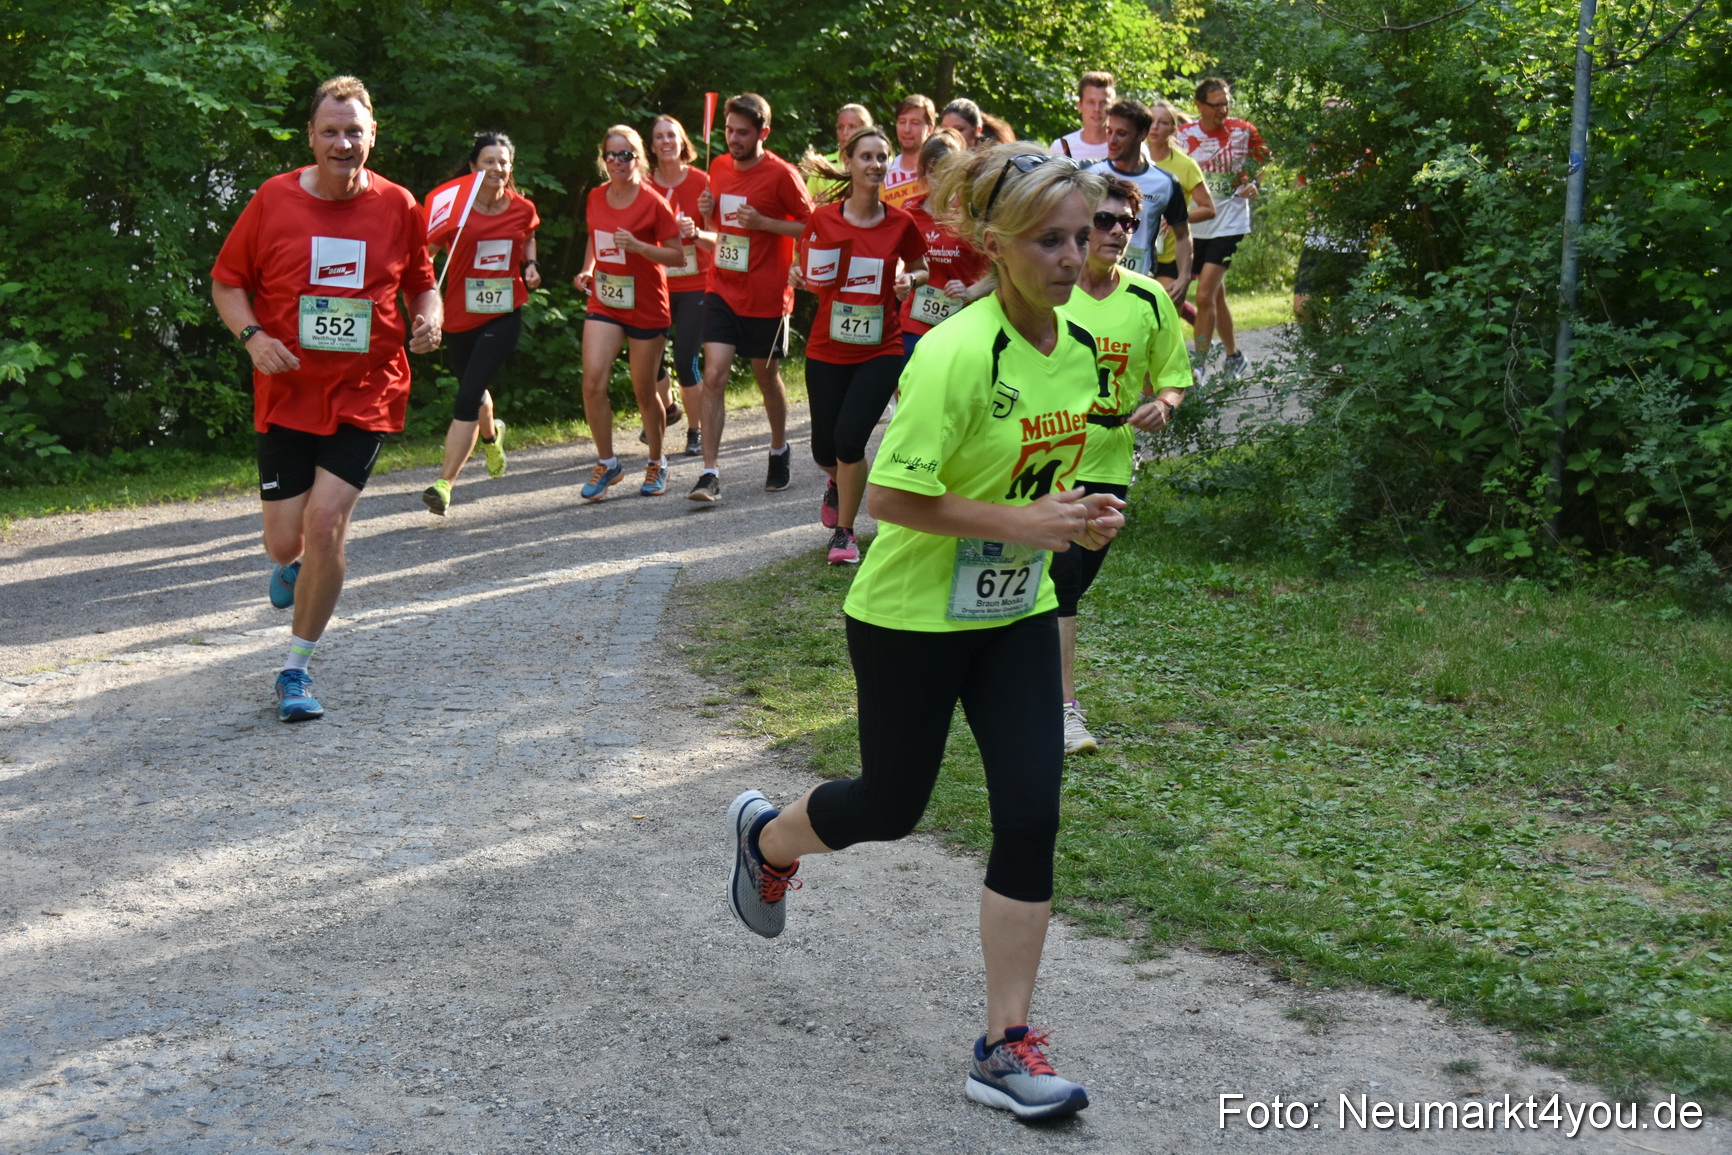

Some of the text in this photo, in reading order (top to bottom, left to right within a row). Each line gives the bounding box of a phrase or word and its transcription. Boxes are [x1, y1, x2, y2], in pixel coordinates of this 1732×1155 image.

[884, 189, 909, 201] MAX
[719, 246, 738, 261] 533
[327, 266, 347, 275] DEHN
[1118, 257, 1136, 271] 80
[475, 291, 503, 304] 497
[601, 285, 624, 299] 524
[922, 299, 950, 317] 595
[315, 316, 355, 336] 552
[840, 318, 870, 334] 471
[1096, 337, 1132, 353] ller
[1019, 410, 1088, 442] Müller
[976, 567, 1030, 599] 672
[1001, 598, 1024, 606] Monika
